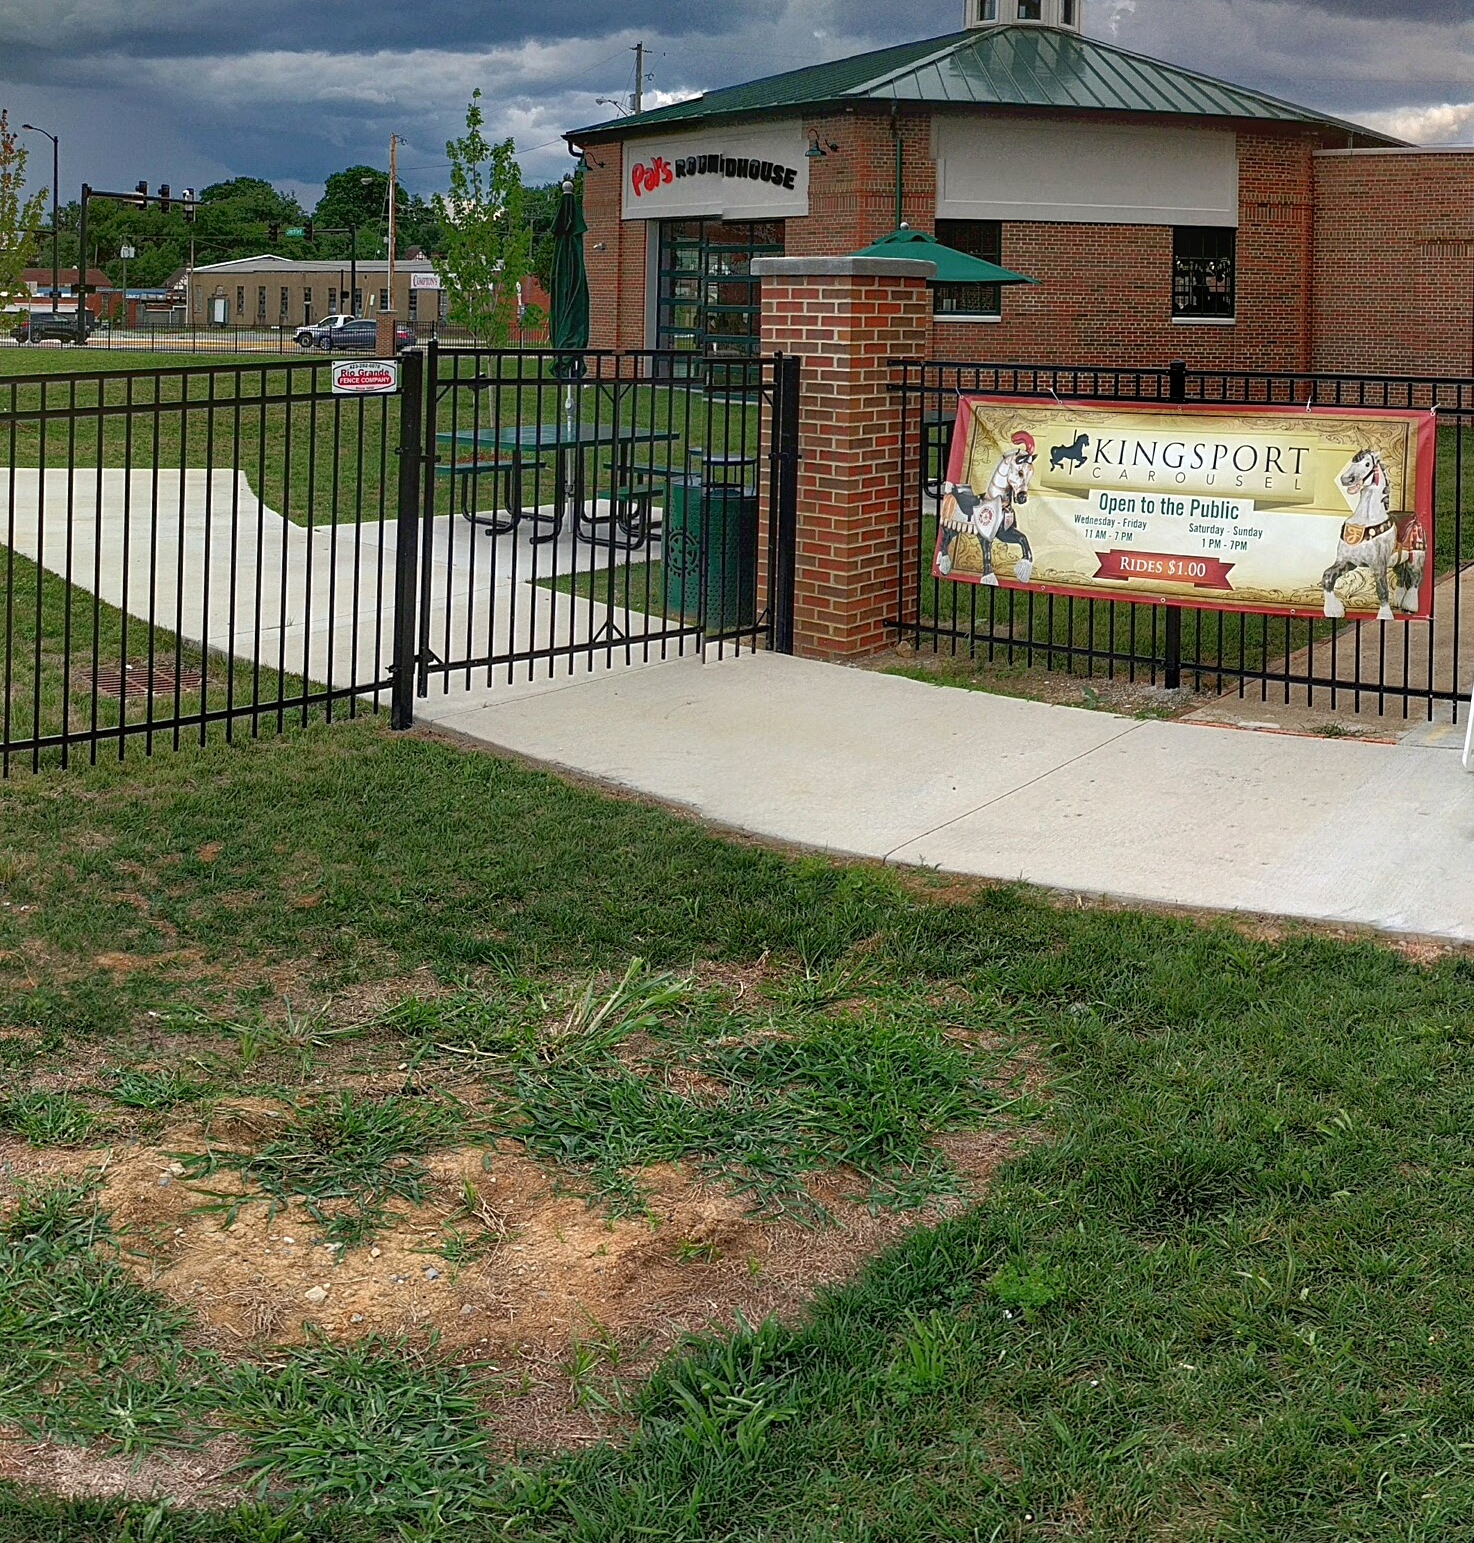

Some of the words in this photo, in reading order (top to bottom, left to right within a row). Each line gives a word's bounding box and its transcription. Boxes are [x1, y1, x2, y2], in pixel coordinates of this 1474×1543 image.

[631, 156, 674, 197] Pal's
[340, 369, 356, 377] Rio
[358, 368, 390, 377] Grande
[1092, 438, 1310, 475] KINGSPORT
[1092, 467, 1302, 491] CAROUSEL
[1099, 492, 1136, 515] Open
[1141, 496, 1155, 514] to
[1160, 497, 1184, 516] the
[1190, 499, 1240, 520] Public
[1074, 514, 1116, 528] Wednesday
[1122, 518, 1148, 531] Friday
[1188, 523, 1225, 536] Saturday
[1233, 526, 1263, 539] Sunday
[1084, 529, 1093, 538] 11
[1094, 530, 1107, 540] AM
[1114, 531, 1119, 540] 7
[1121, 532, 1133, 542] PM
[1201, 538, 1206, 548] 1
[1208, 539, 1221, 549] PM
[1230, 540, 1248, 551] 7PM
[1167, 561, 1206, 578] $1.00
